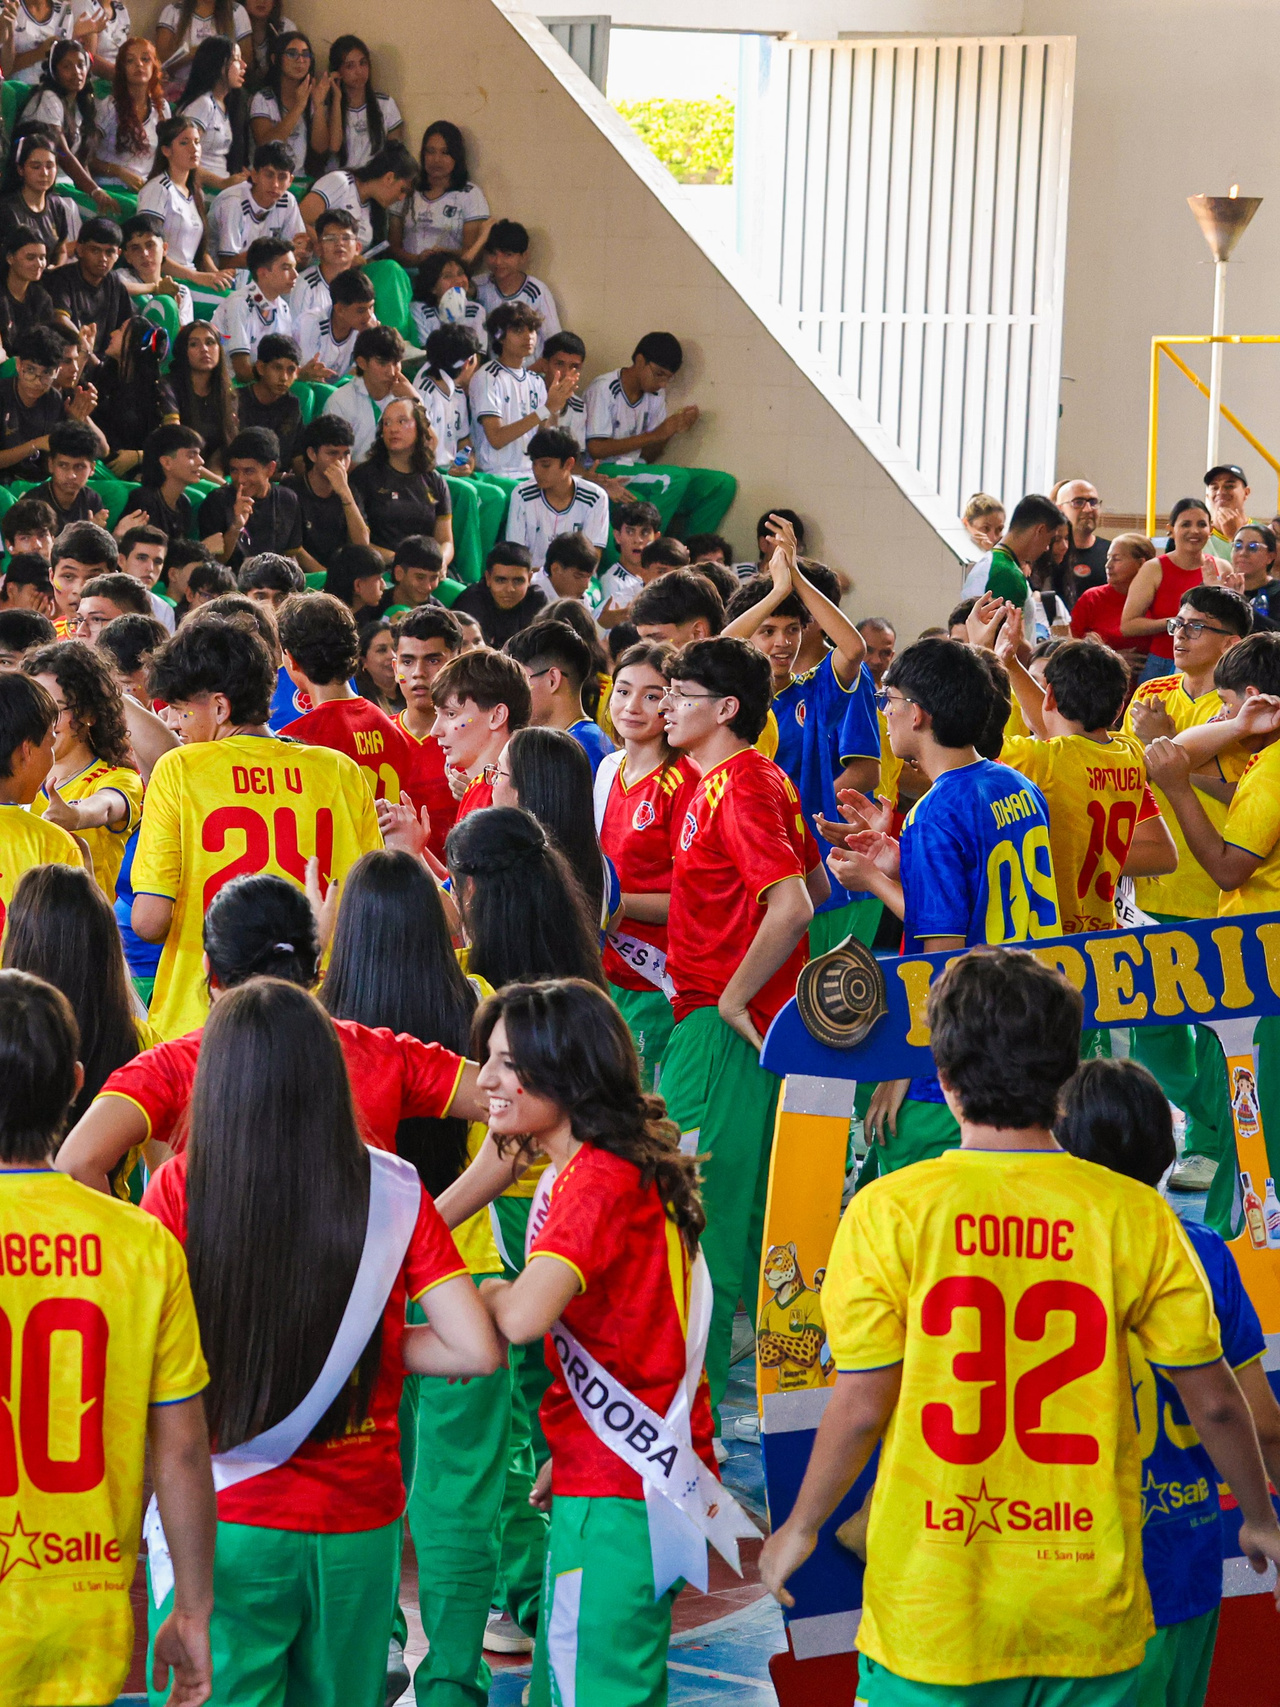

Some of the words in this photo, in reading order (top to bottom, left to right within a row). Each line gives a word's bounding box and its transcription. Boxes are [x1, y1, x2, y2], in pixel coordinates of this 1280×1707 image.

[232, 766, 275, 795] DEI
[1086, 767, 1142, 792] SAMUEL
[989, 789, 1037, 830] JOHAN
[201, 806, 333, 918] 24
[1077, 800, 1137, 903] 19
[985, 825, 1063, 945] 09
[955, 1213, 1075, 1262] CONDE
[921, 1275, 1108, 1465] 32
[551, 1327, 679, 1479] ORDOBA
[925, 1500, 964, 1531] La
[1007, 1500, 1094, 1532] Salle
[43, 1531, 122, 1564] Salle
[1055, 1550, 1073, 1560] San
